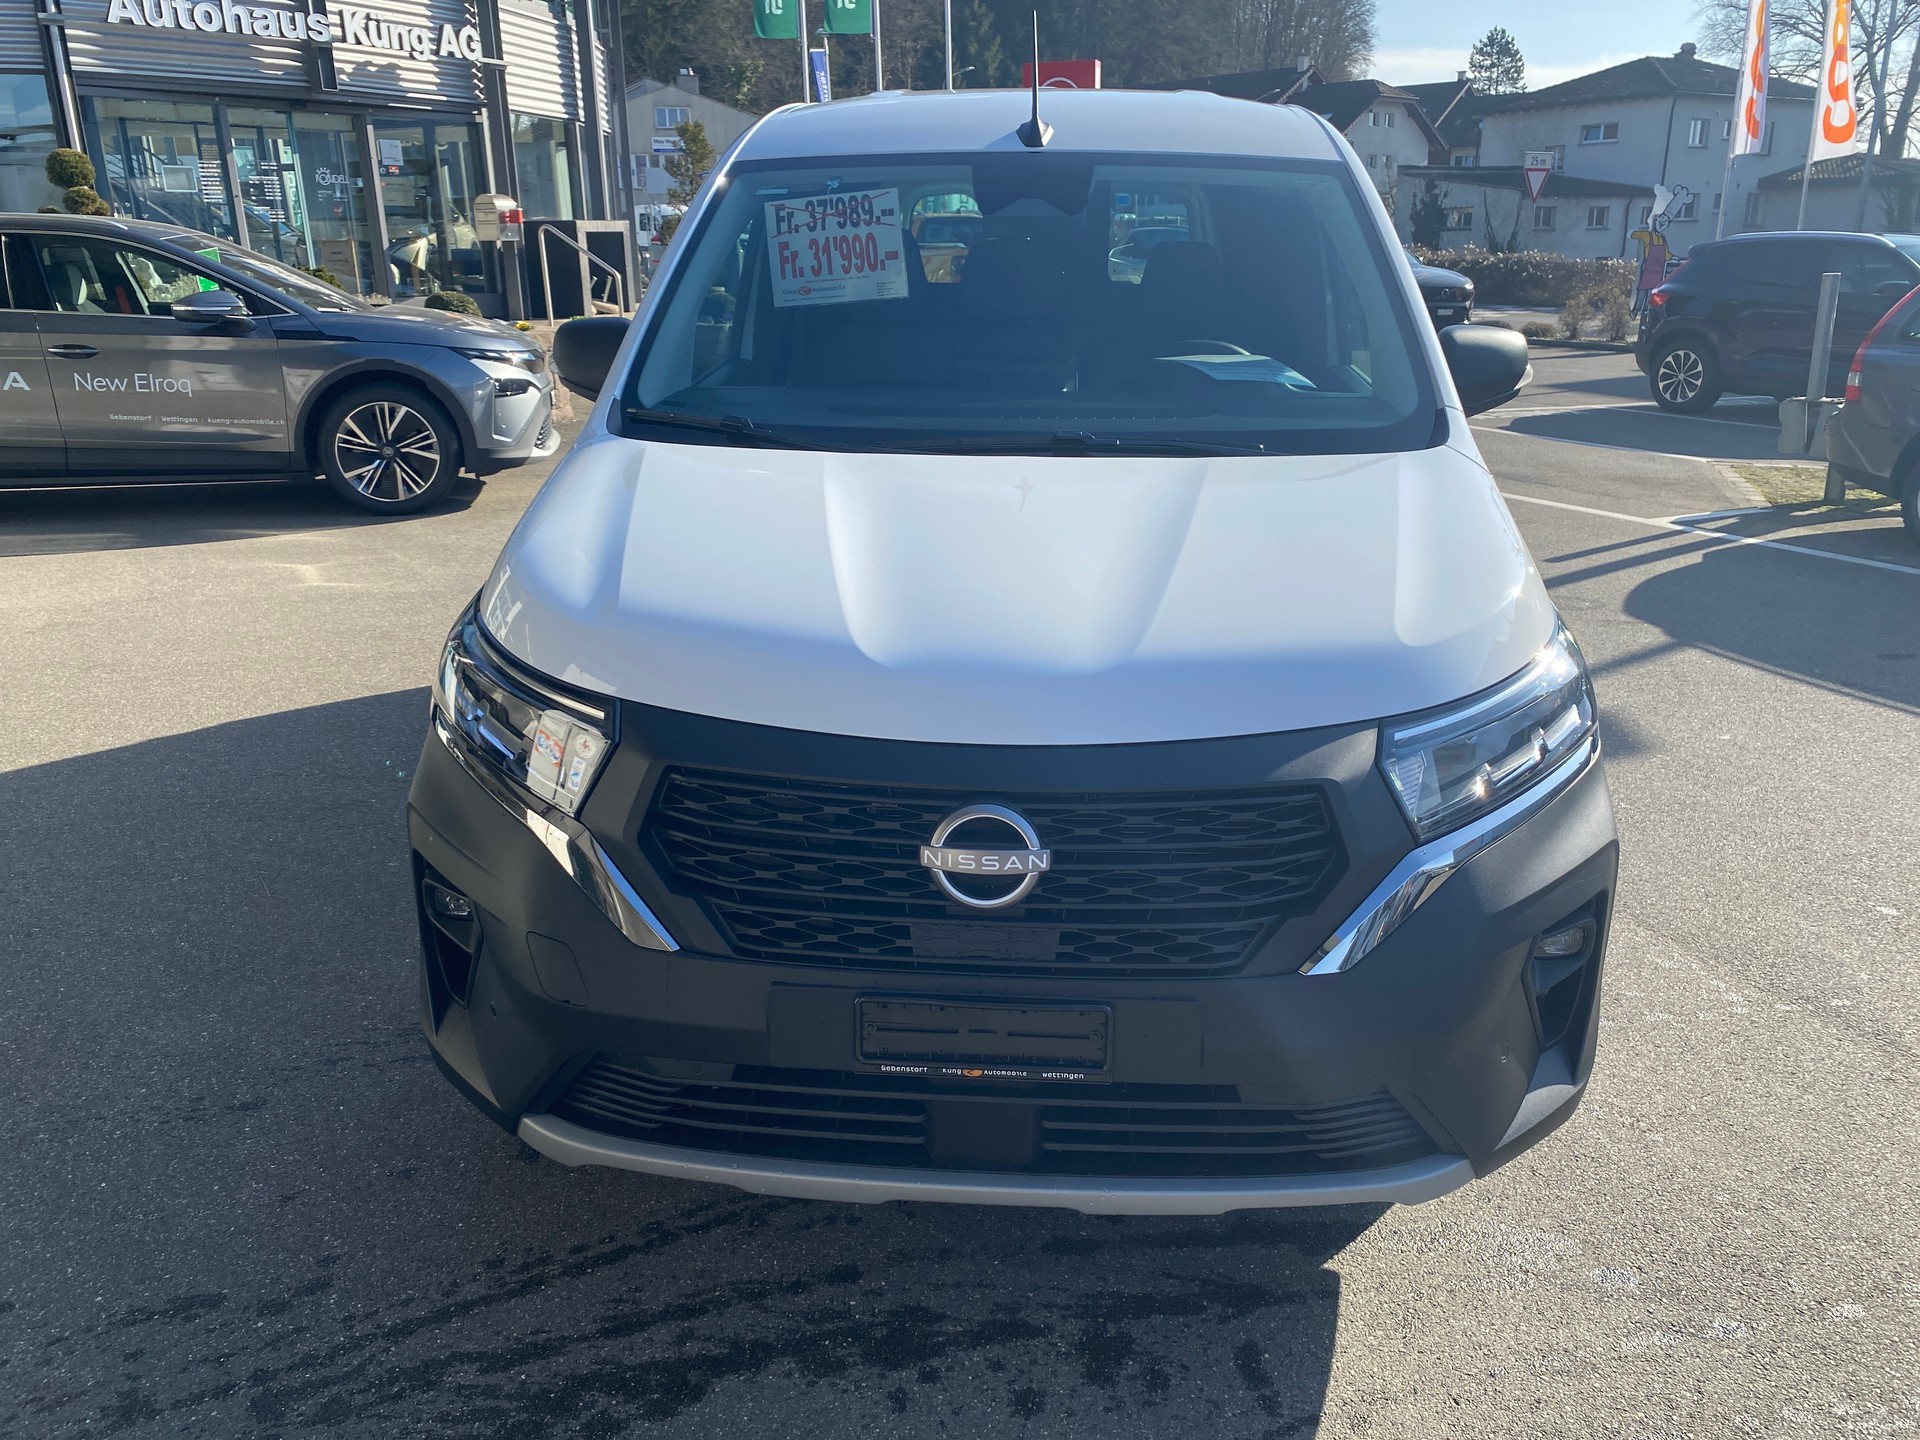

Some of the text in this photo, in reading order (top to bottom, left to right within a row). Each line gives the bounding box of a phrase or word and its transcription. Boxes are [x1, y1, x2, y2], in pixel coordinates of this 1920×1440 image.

[107, 0, 482, 61] Autohaus Küng AG
[1530, 156, 1547, 166] 25 m
[774, 204, 800, 235] Fr.
[778, 241, 804, 279] Fr.
[73, 372, 193, 398] New Elroq
[109, 413, 286, 426] Gebenstorf Wettingen kueng-automobile.ch
[923, 849, 1048, 871] NISSAN
